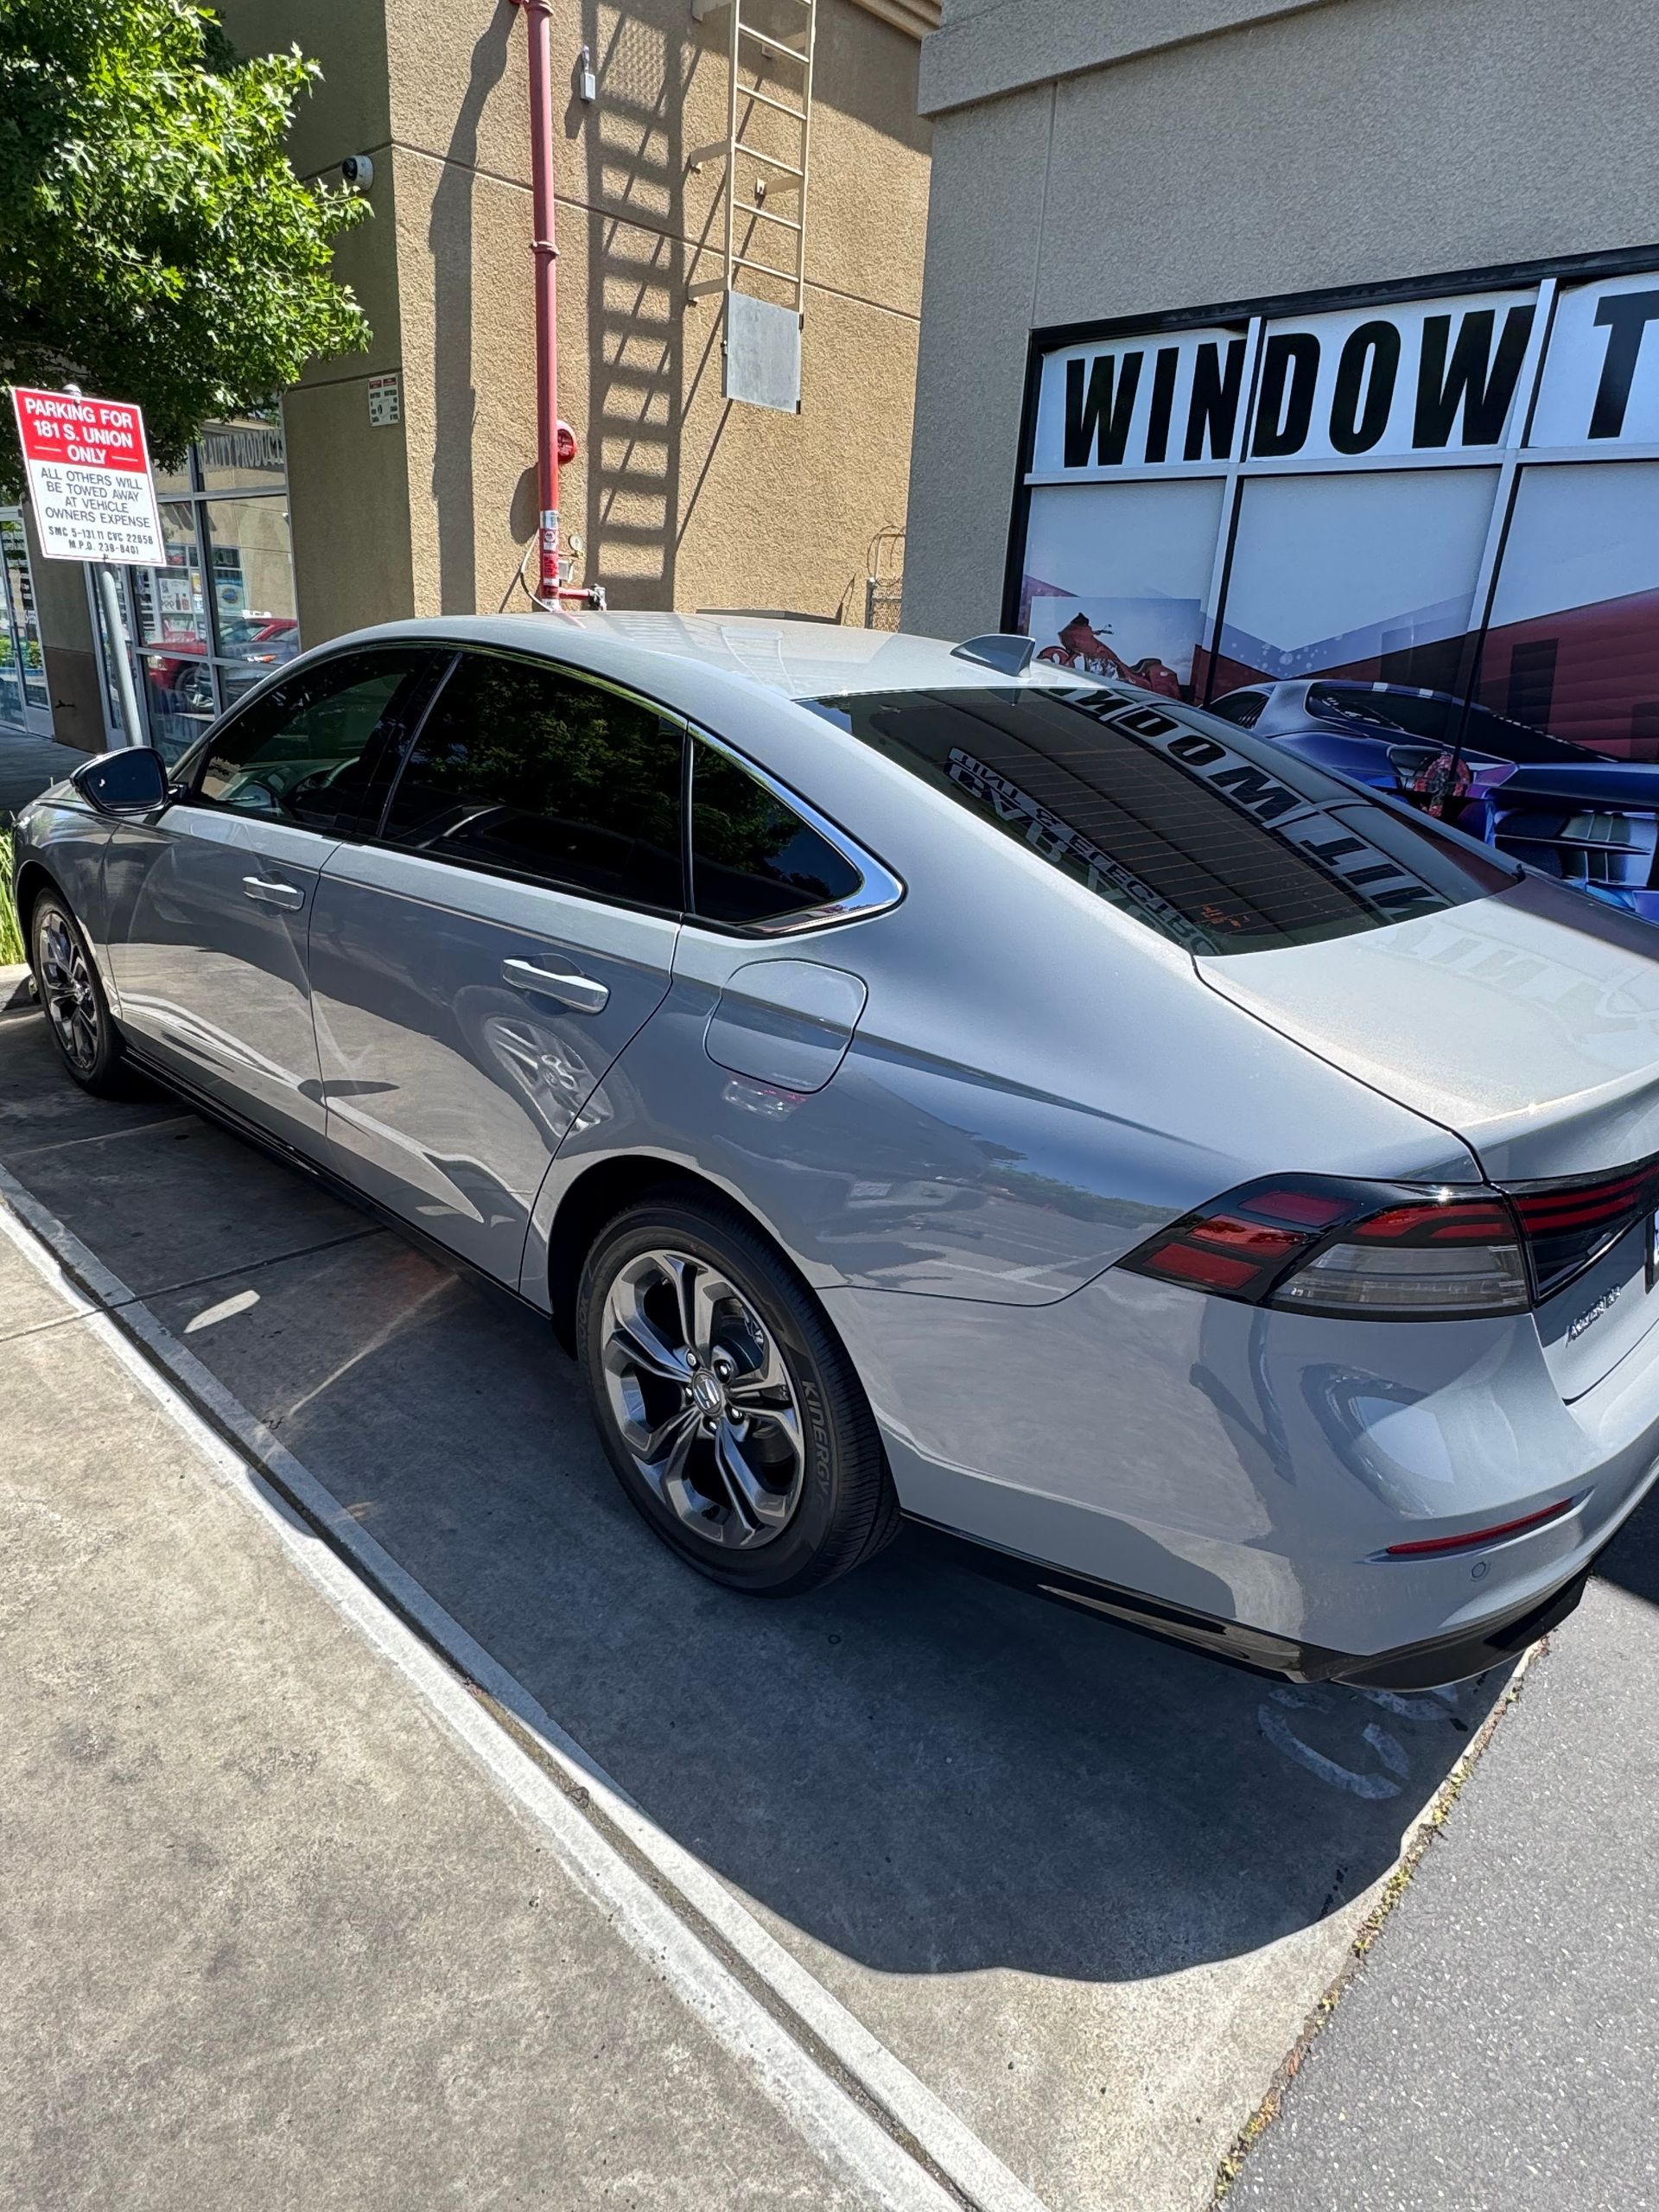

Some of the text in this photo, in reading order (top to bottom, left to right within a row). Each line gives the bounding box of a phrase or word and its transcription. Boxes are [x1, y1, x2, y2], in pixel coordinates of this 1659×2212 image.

[1063, 303, 1538, 468] WINDOW
[24, 397, 134, 429] PARKING FOR
[33, 419, 134, 449] 181 S. UNION
[67, 443, 106, 465] ONLY
[197, 433, 232, 474] BAUTY
[41, 467, 143, 491] ALL OTHERS WILL
[46, 480, 139, 502] BE TOWED AWAY
[65, 495, 130, 514] AT VEHICLE
[45, 506, 151, 529] OWNERS EXPENSE
